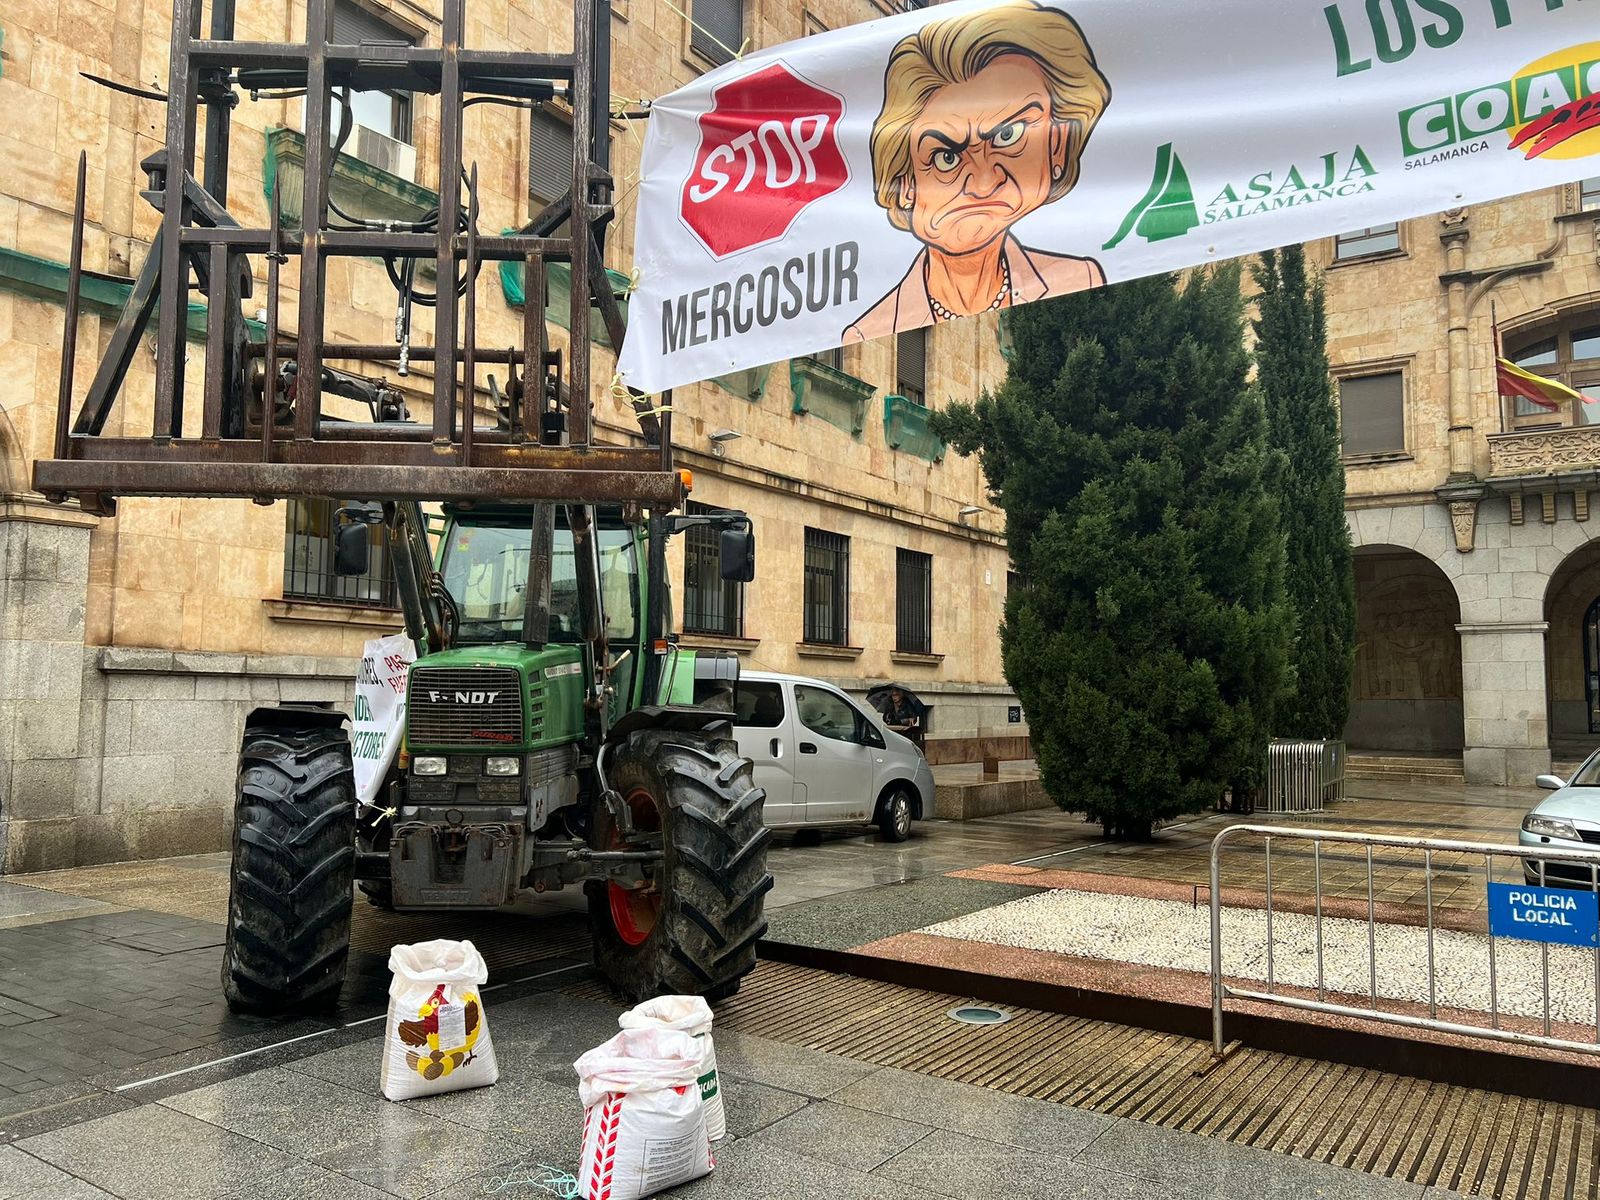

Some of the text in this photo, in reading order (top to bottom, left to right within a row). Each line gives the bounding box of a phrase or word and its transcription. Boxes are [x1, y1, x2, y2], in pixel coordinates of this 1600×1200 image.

[1324, 0, 1463, 77] LOS
[690, 114, 829, 203] STOP
[1207, 144, 1379, 206] ASAJA
[1404, 140, 1489, 170] SALAMANCA
[1203, 181, 1376, 225] SALAMANCA
[662, 241, 859, 355] MERCOSUR
[428, 690, 502, 704] FNDT
[1509, 891, 1577, 910] POLICIA
[1513, 908, 1573, 926] LOCAL
